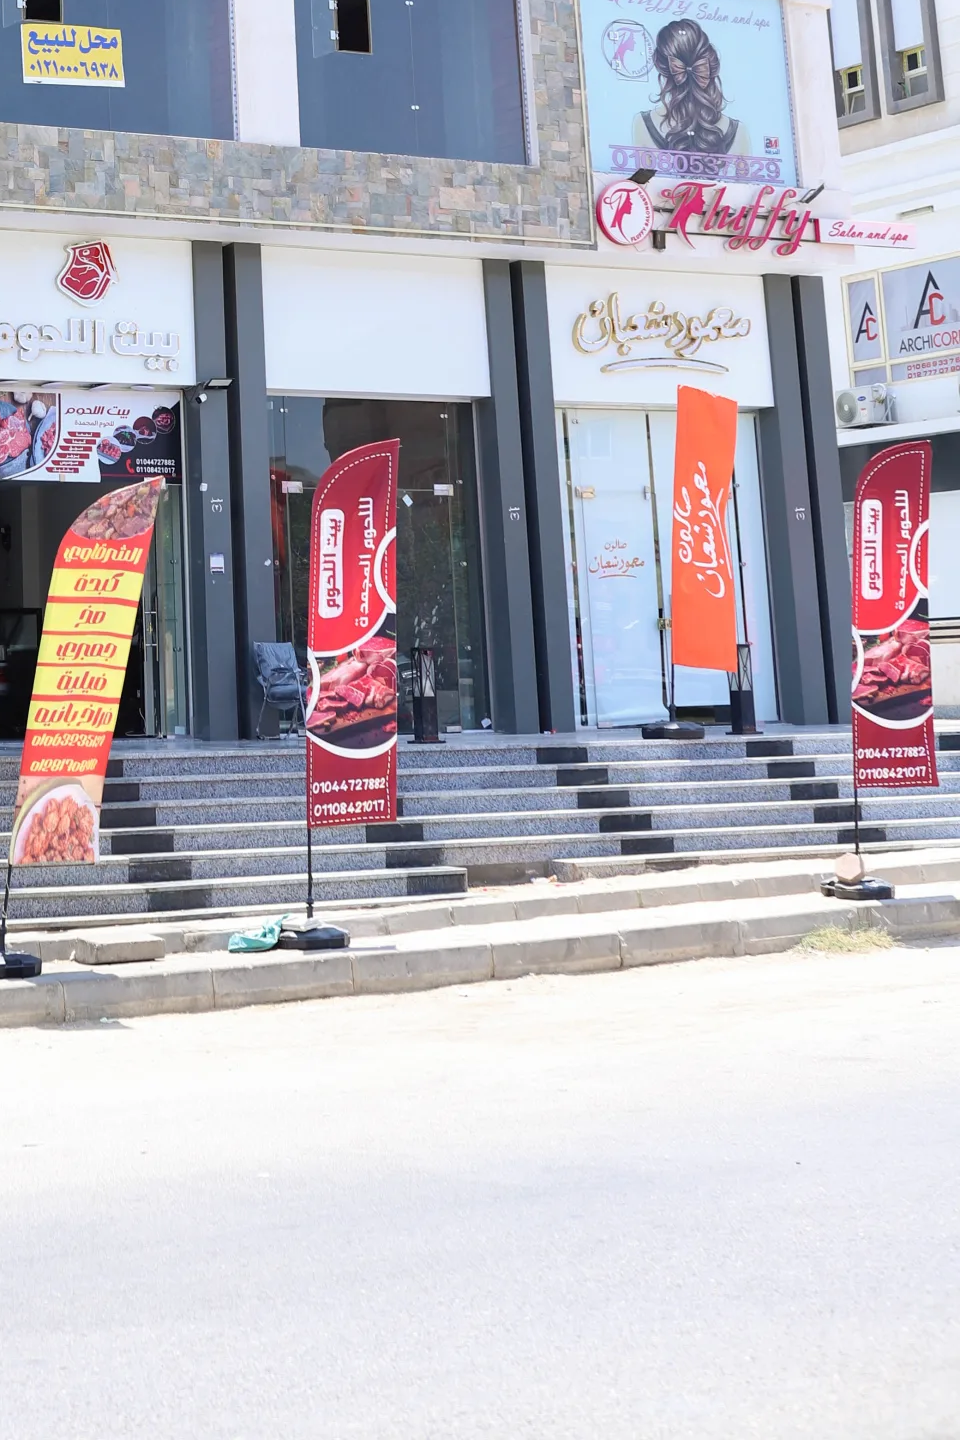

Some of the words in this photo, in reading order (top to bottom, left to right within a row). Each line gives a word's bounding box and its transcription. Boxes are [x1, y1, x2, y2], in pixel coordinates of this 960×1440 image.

[28, 28, 77, 55] للبيع
[79, 28, 118, 53] محل
[30, 59, 119, 79] ٠١٢١٠٠٠٦٩٣٨
[612, 149, 781, 179] 01080537929
[828, 221, 863, 239] Salon
[866, 227, 890, 240] and
[889, 233, 909, 245] spa
[572, 291, 674, 356] شعبان
[110, 321, 181, 372] بيت
[899, 330, 960, 354] ARCHICOR
[65, 405, 105, 416] اللحوم
[106, 405, 131, 419] بيت
[357, 497, 377, 550] للحوم
[673, 486, 695, 564] صالون
[867, 507, 880, 536] بيت
[894, 490, 912, 541] للحوم
[327, 518, 342, 548] بيت
[63, 542, 144, 565] الشرقاوي
[863, 540, 881, 593] اللحوم
[73, 572, 125, 595] كبدة
[322, 553, 341, 610] اللحوم
[894, 544, 909, 611] المجمدة
[354, 554, 373, 628] المجمدة
[56, 641, 118, 662] جمبري
[857, 746, 927, 759] 01044727882
[312, 777, 386, 794] 01044727882
[858, 765, 927, 781] 01108421017
[313, 799, 385, 818] 01108421017
